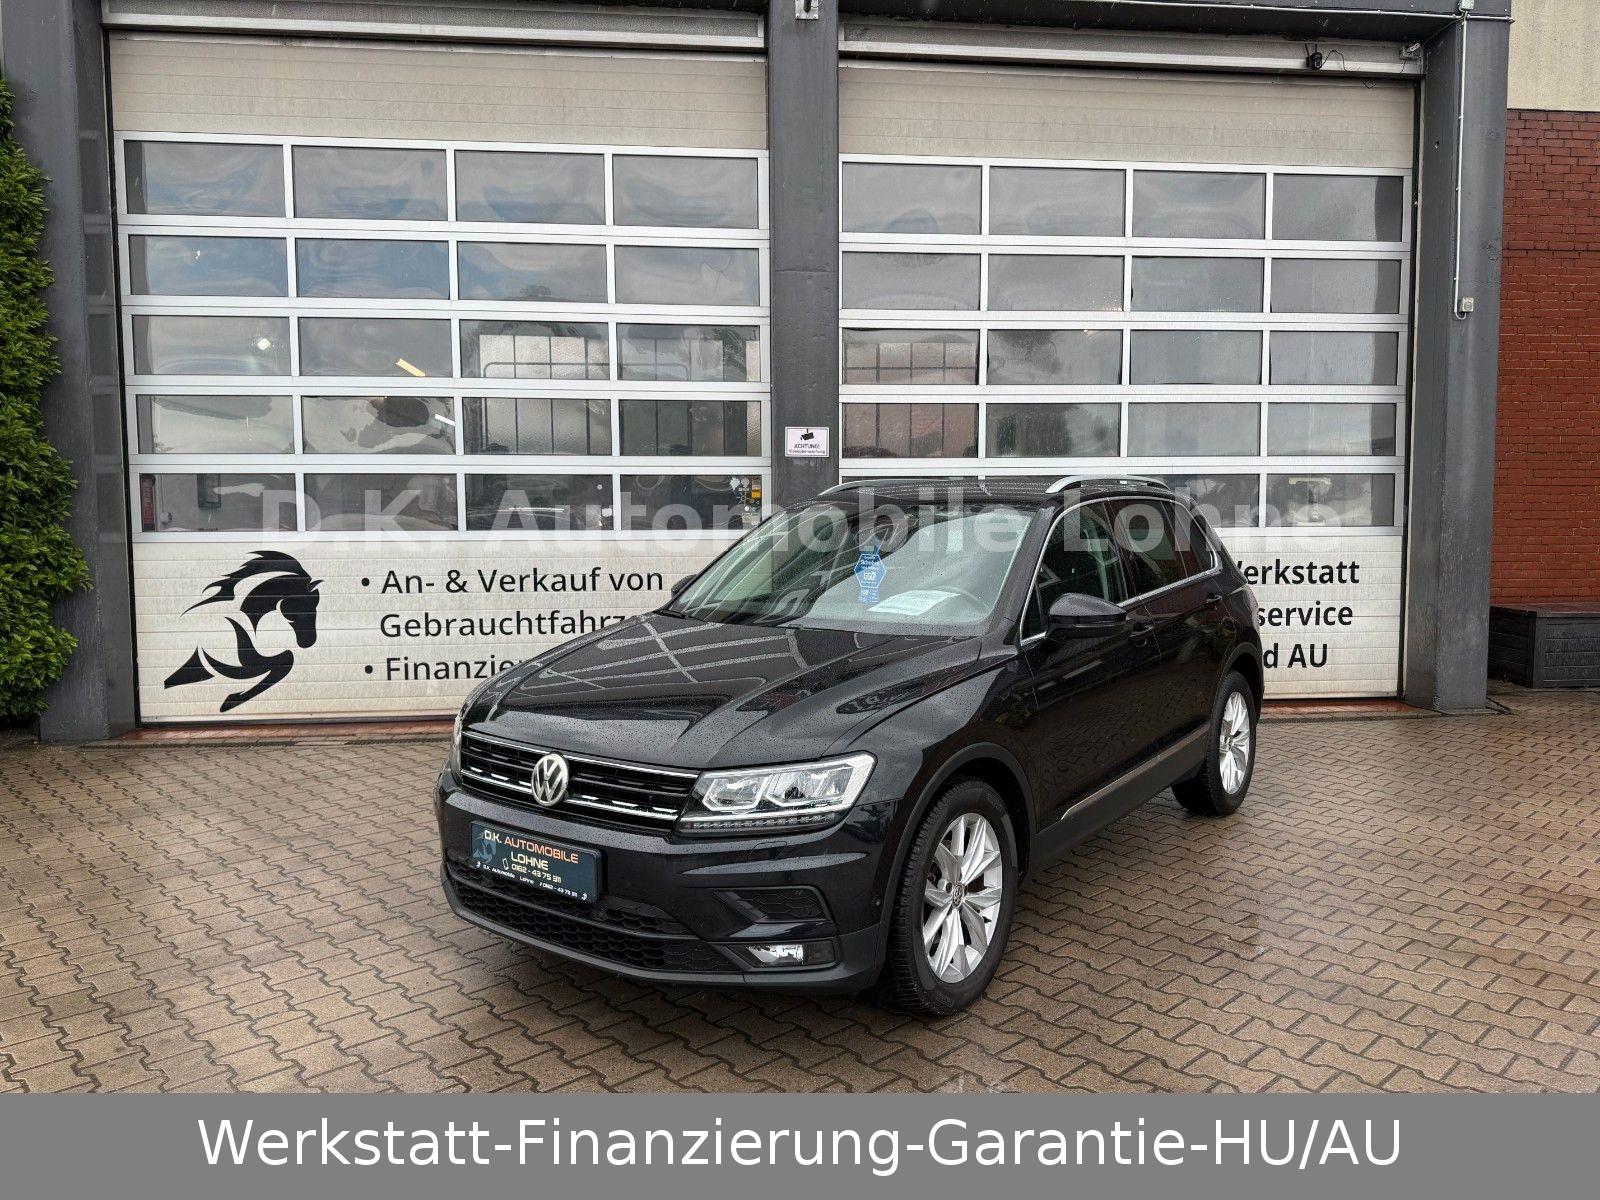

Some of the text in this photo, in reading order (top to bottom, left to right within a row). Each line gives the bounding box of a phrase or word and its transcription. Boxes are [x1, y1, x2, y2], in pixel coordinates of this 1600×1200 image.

[381, 566, 664, 594] An- & Verkauf von
[1237, 558, 1360, 585] erkstatt
[386, 654, 522, 681] Finanzie
[1287, 643, 1328, 668] AU
[504, 836, 579, 864] AUTOMOBILE
[510, 851, 549, 871] LOHNE
